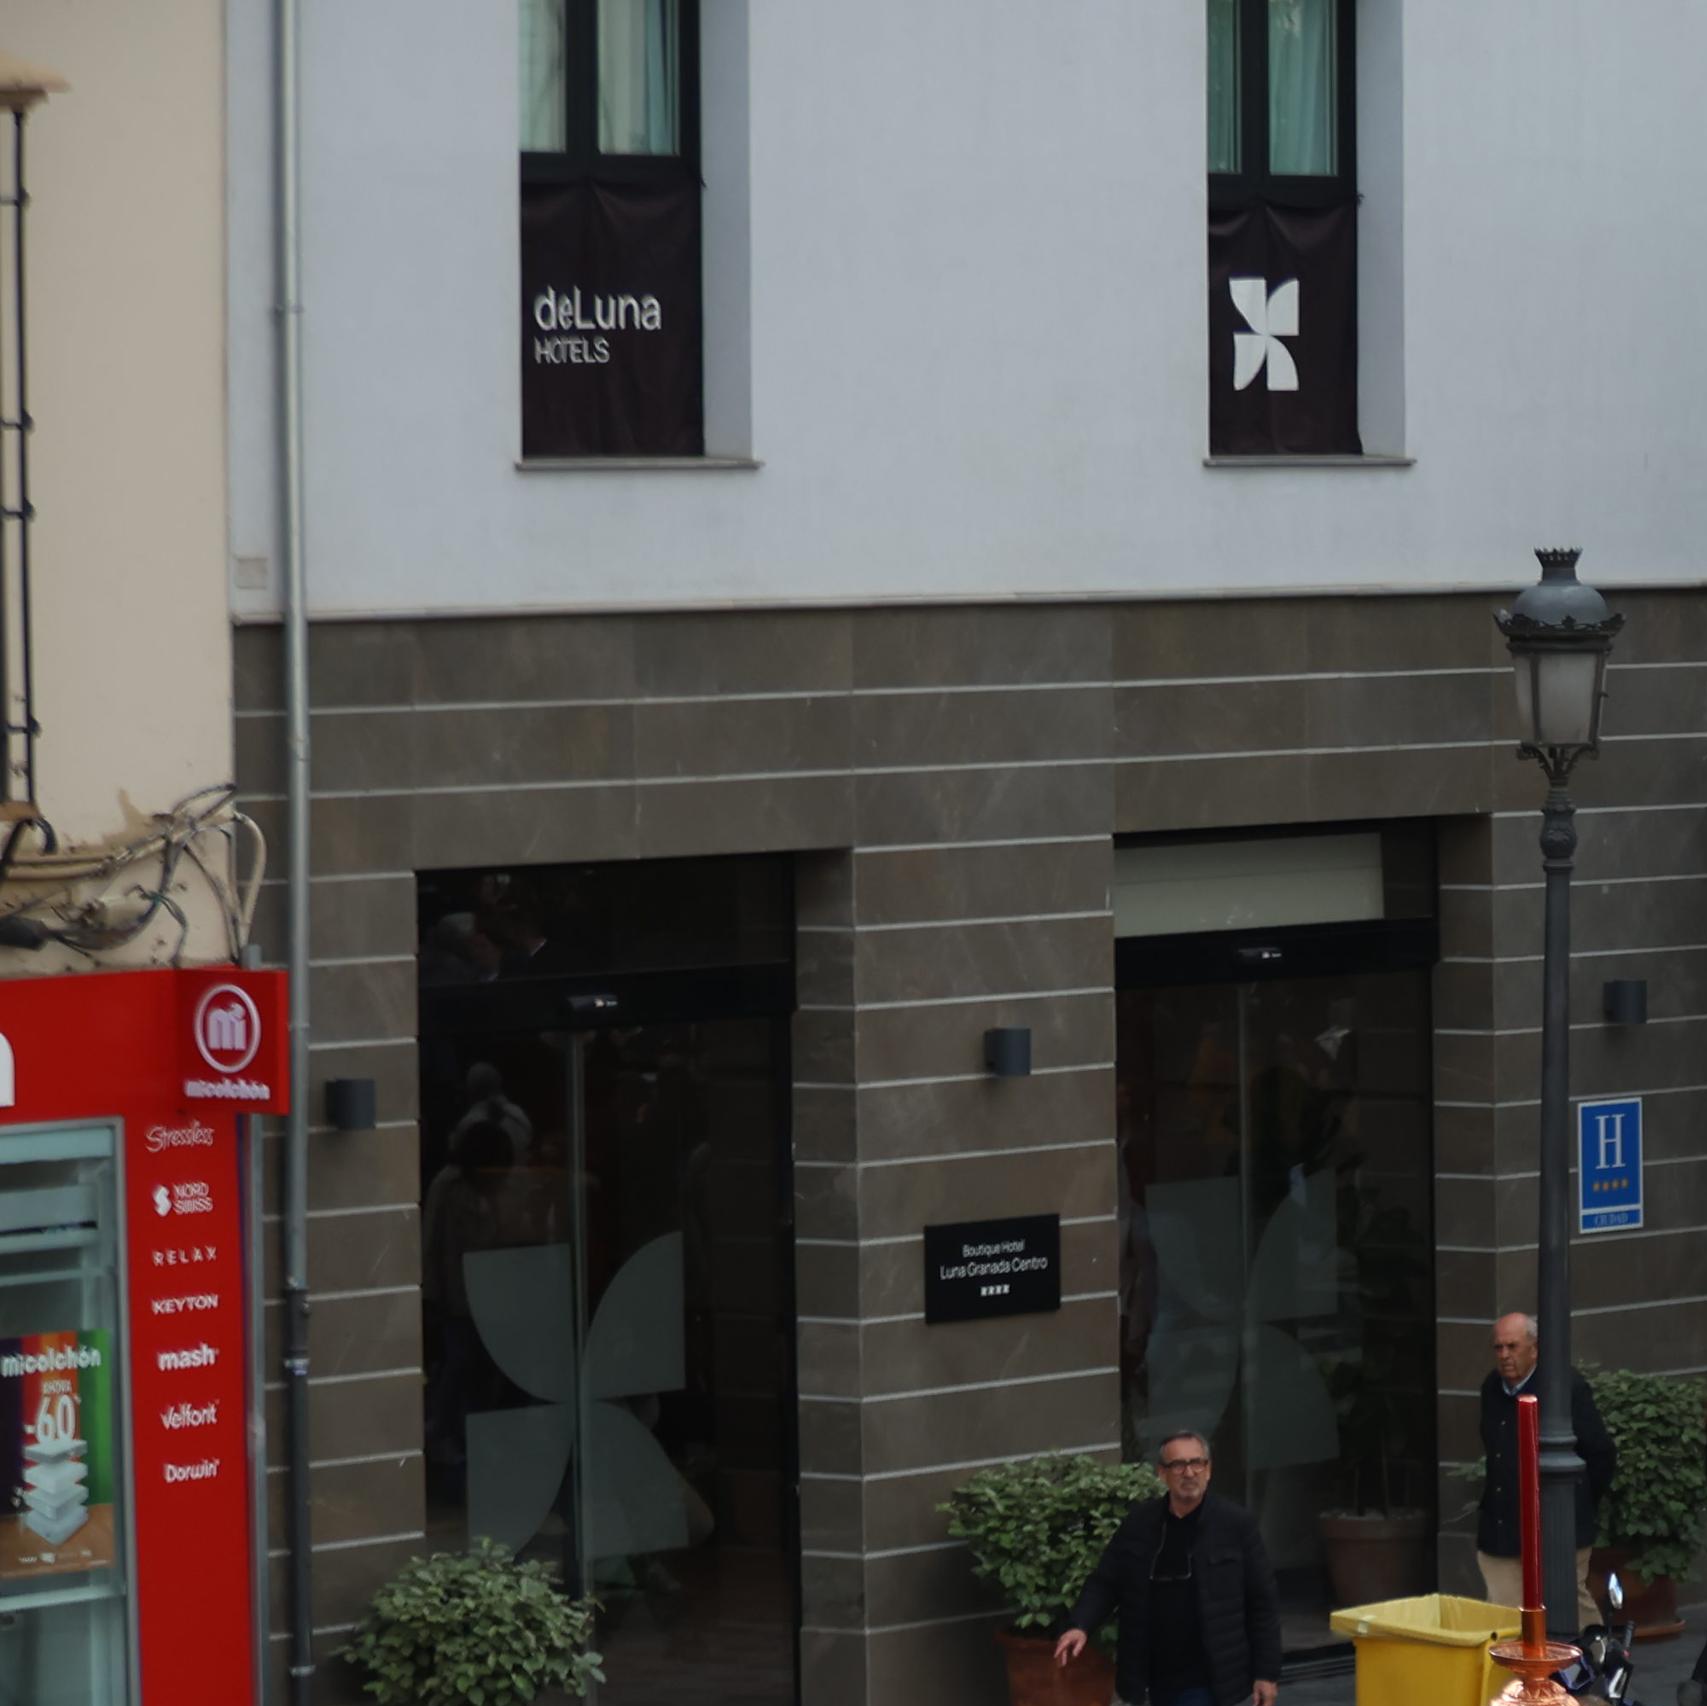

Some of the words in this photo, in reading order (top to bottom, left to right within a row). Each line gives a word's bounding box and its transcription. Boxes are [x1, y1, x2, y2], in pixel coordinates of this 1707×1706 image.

[533, 285, 662, 332] deLuna
[533, 335, 611, 364] HOTELS
[1594, 1113, 1627, 1170] H
[152, 1246, 217, 1267] RELAX
[962, 1243, 1000, 1258] Boutique
[1001, 1239, 1025, 1253] Hotel
[940, 1264, 966, 1280] Luna
[967, 1259, 1010, 1276] Granada
[1011, 1256, 1048, 1272] Centro
[152, 1293, 219, 1315] KEYTON
[1, 1344, 102, 1378] micolchón
[157, 1342, 217, 1372] mash
[160, 1401, 218, 1430] Velfont
[163, 1458, 219, 1484] Dorwin
